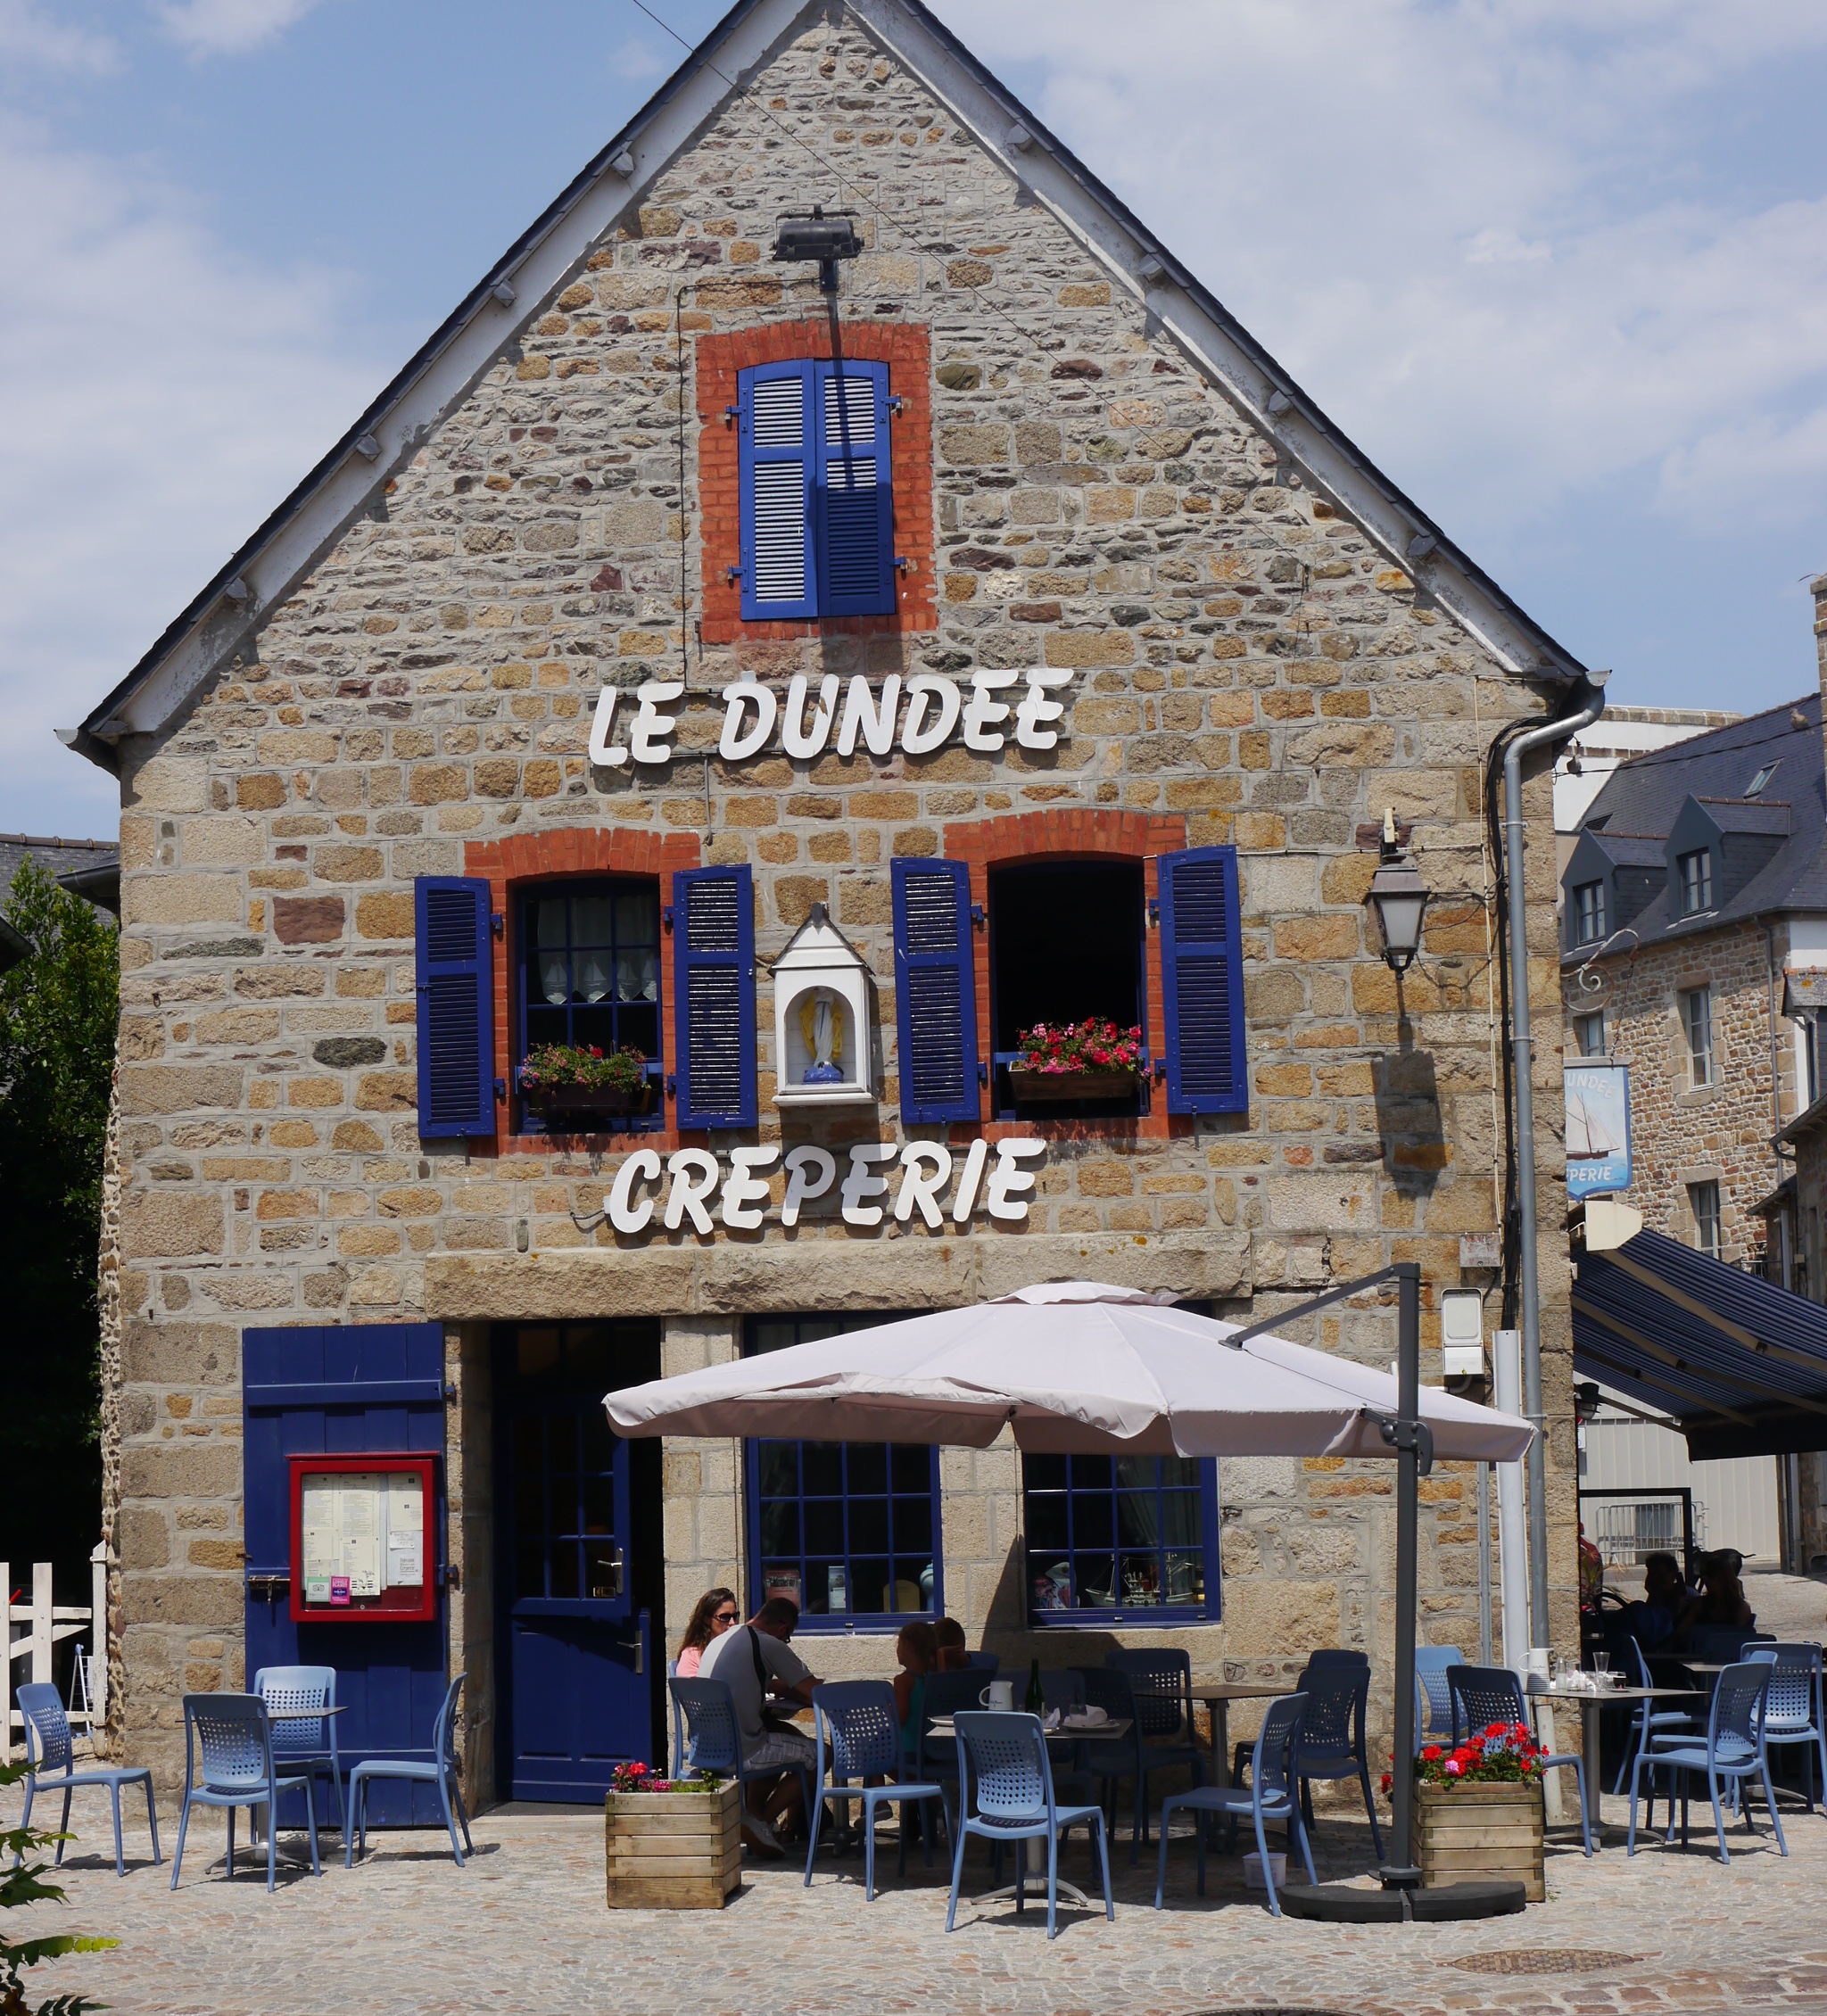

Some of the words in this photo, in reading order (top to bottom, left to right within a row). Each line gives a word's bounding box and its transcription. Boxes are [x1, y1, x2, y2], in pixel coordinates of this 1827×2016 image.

[589, 682, 684, 766] LE
[719, 666, 1074, 761] DUNDEE
[609, 1137, 1046, 1235] CREPERIE
